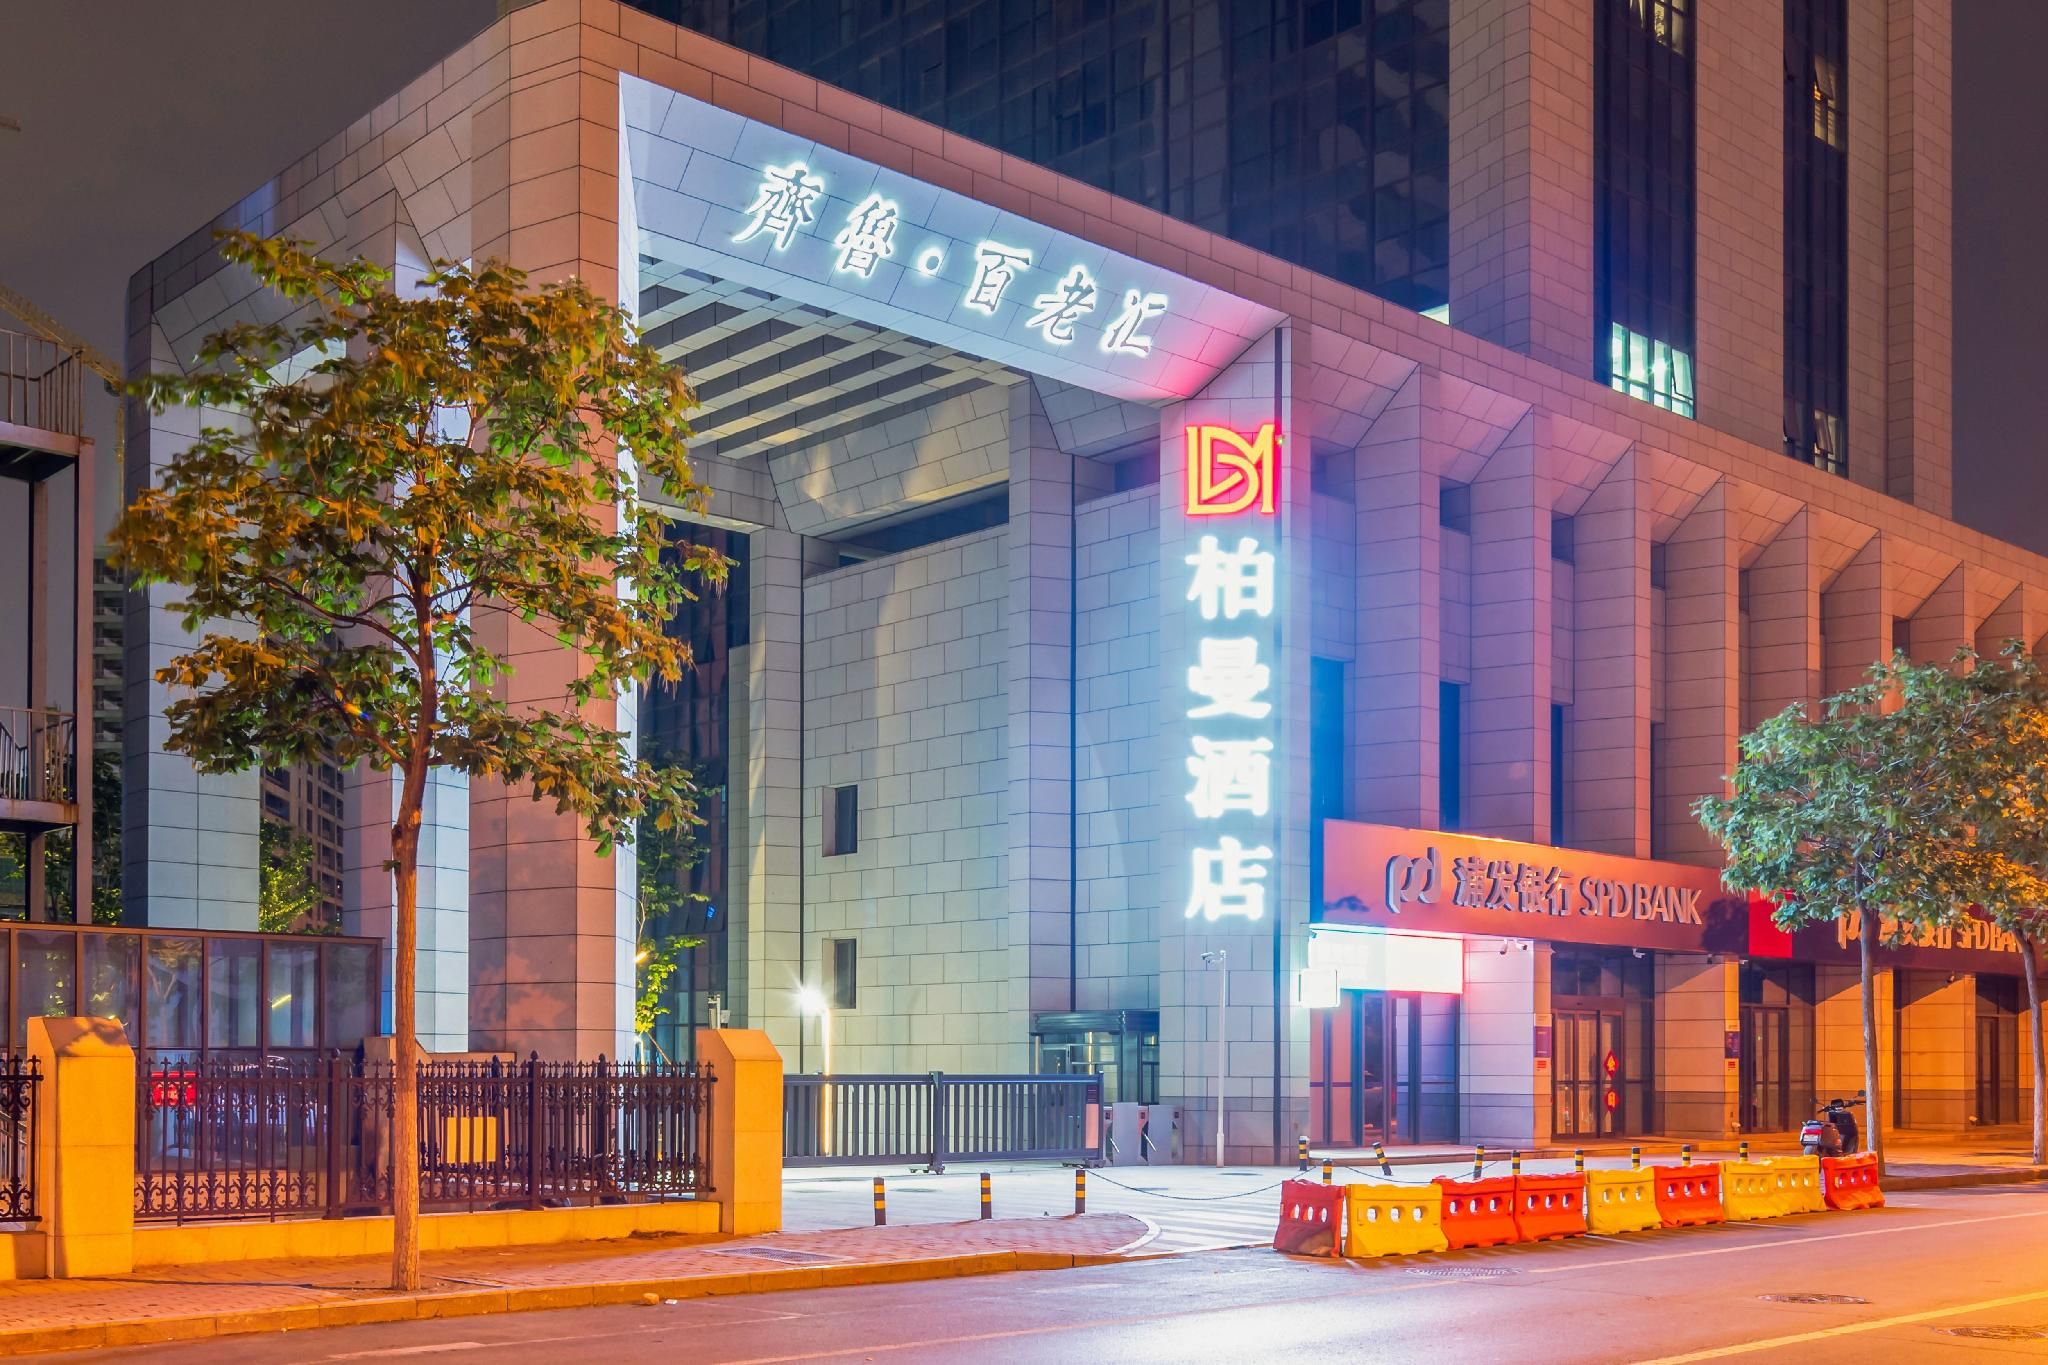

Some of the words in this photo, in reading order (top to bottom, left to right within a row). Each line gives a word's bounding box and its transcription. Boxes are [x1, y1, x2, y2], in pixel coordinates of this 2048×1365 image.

[1184, 535, 1275, 922] 柏曼酒店
[1452, 856, 1574, 916] 浦发银行
[1579, 876, 1631, 918] SPD
[1632, 882, 1703, 925] BANK
